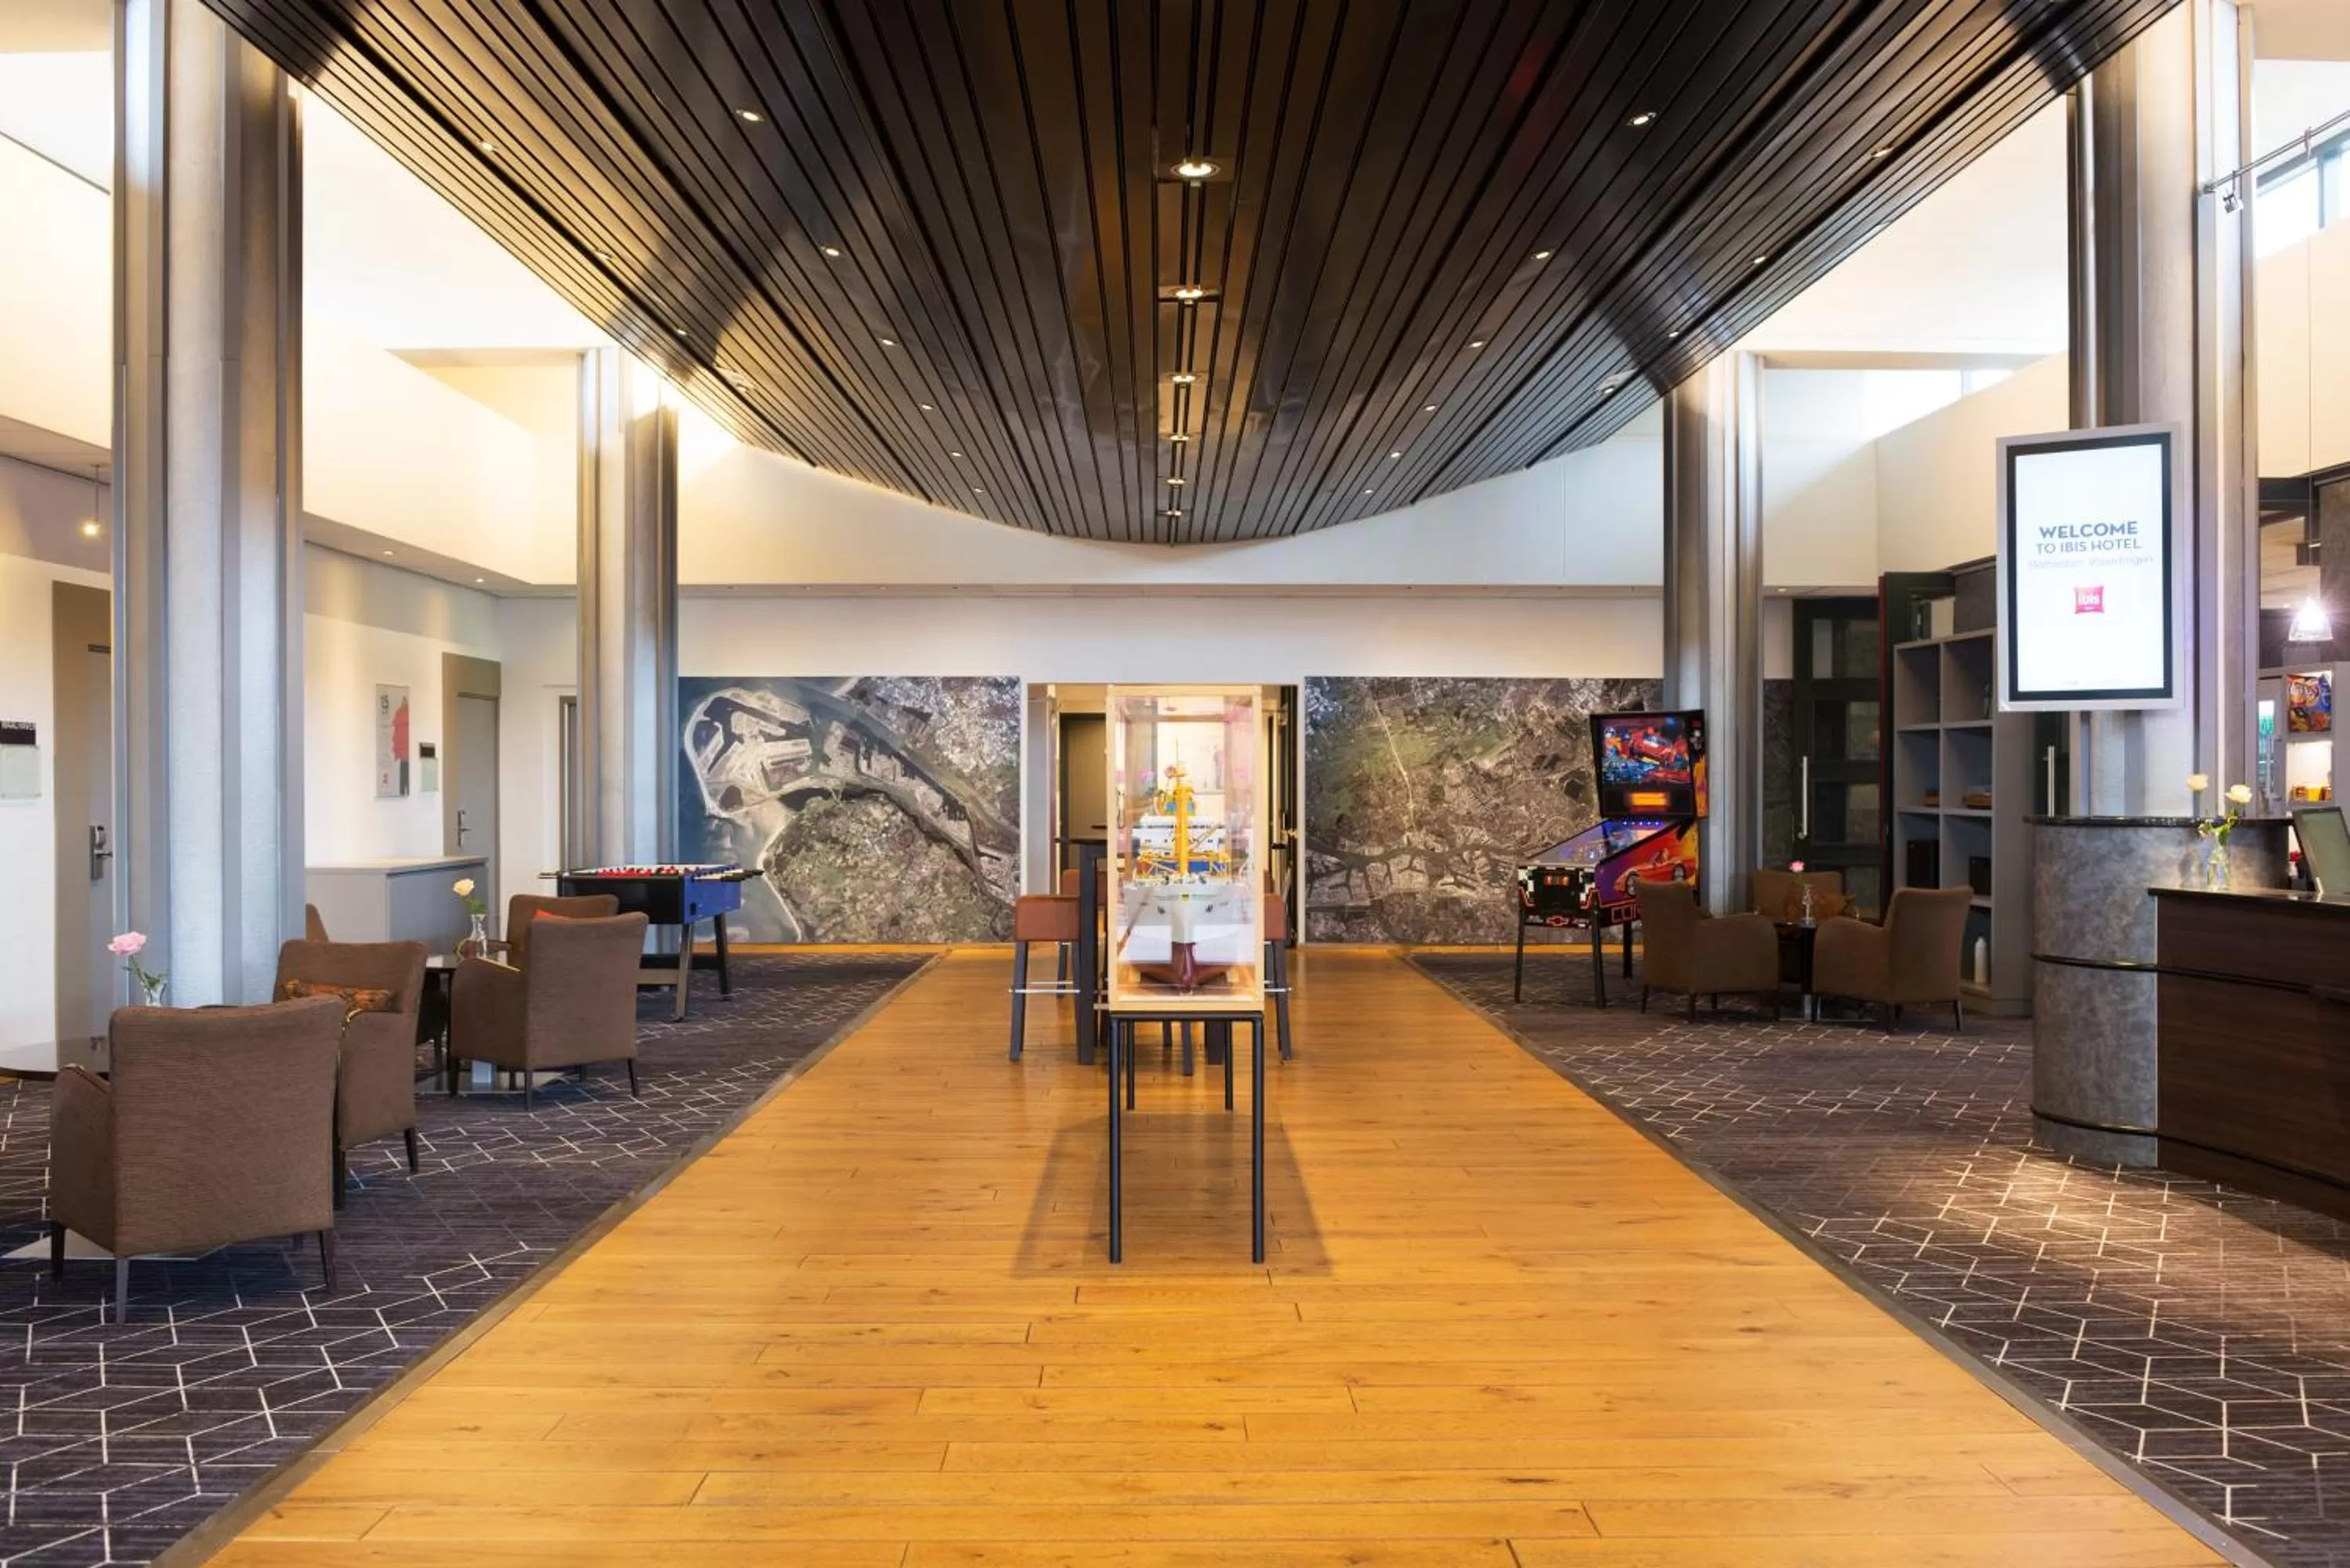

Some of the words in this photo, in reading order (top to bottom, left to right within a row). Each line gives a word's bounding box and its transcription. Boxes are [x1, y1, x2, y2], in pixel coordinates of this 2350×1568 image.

[2038, 521, 2138, 540] WELCOME
[2036, 543, 2056, 555] TO
[2060, 541, 2088, 552] IBIS
[2091, 538, 2143, 551] HOTEL
